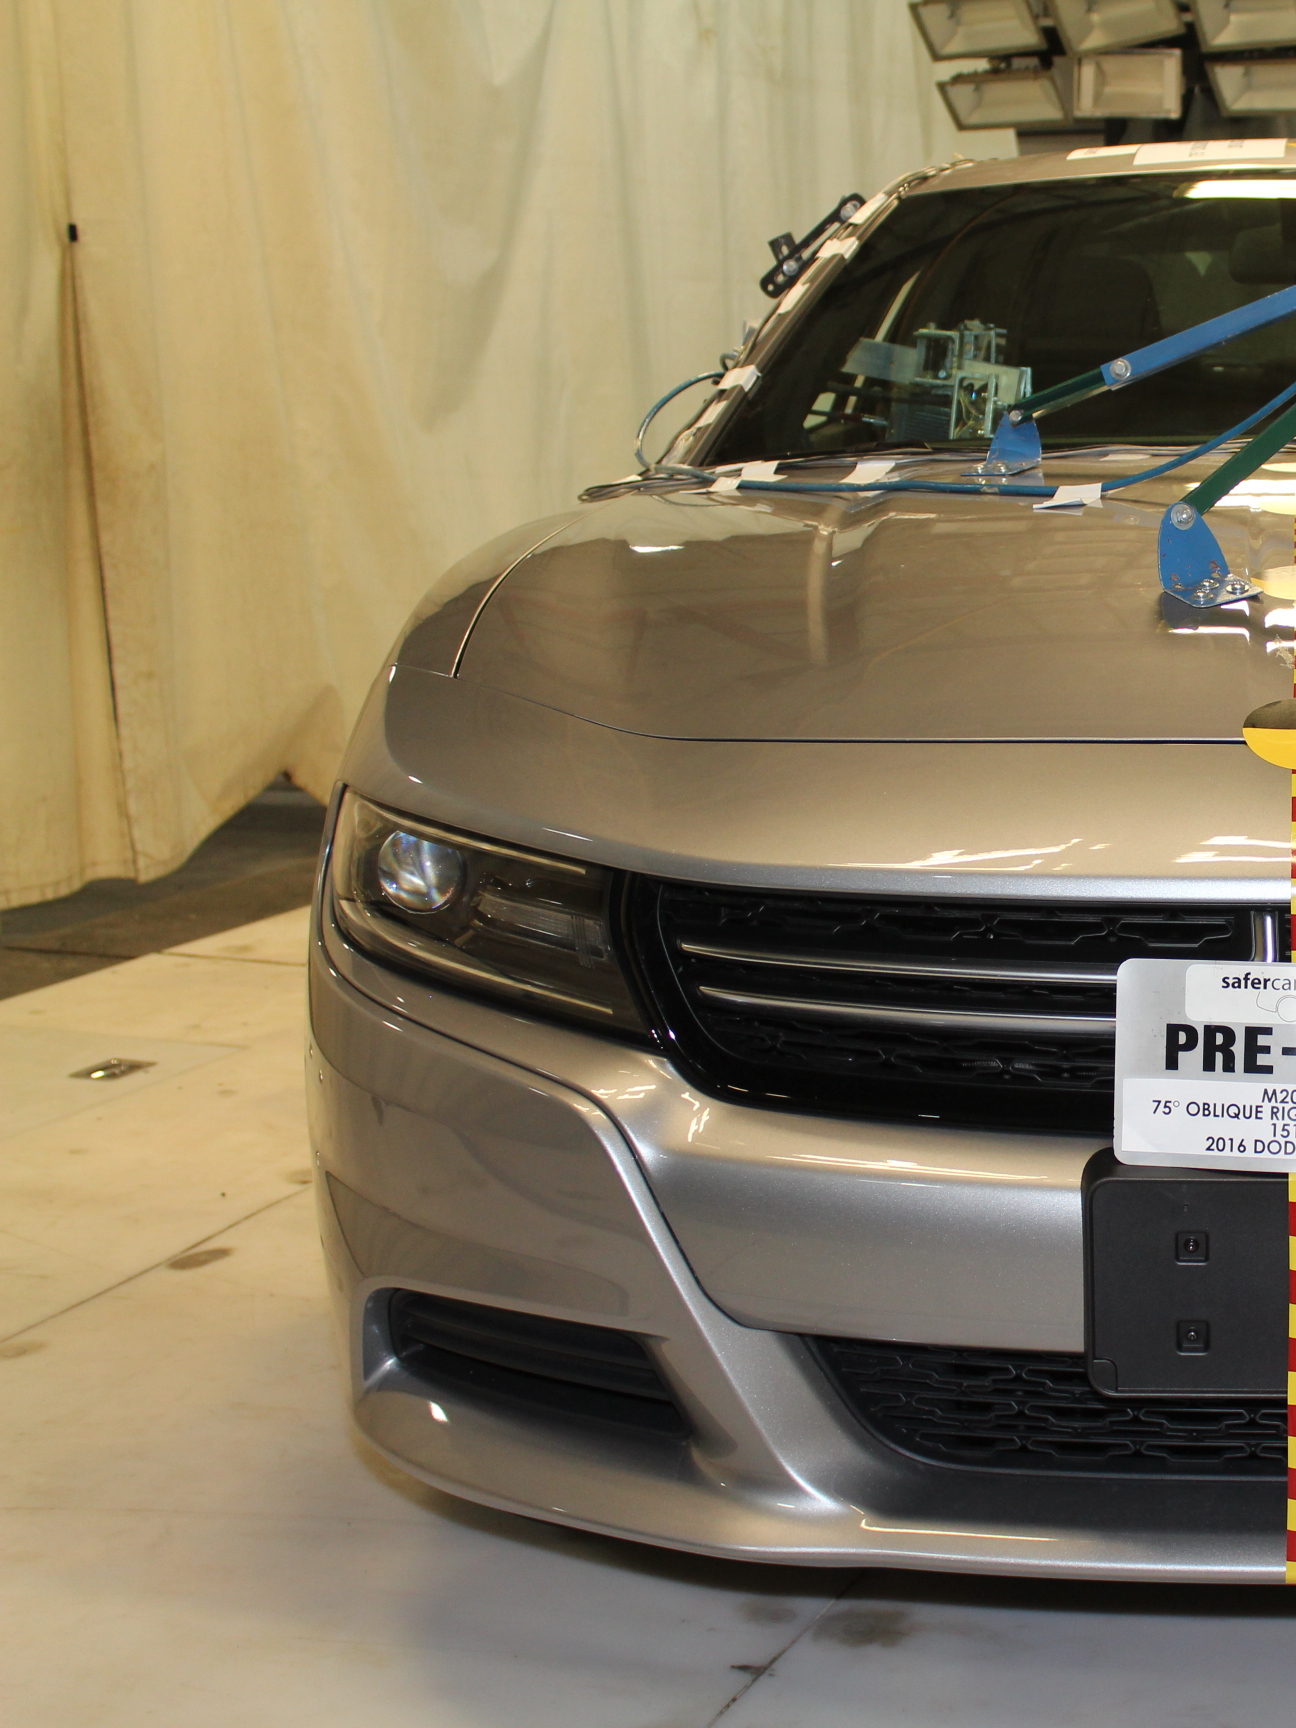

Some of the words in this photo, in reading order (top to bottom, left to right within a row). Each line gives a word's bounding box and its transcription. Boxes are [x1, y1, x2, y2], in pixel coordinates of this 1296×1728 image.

[1151, 1099, 1181, 1116] 75°
[1185, 1101, 1264, 1120] OBLIQUE
[1204, 1136, 1247, 1154] 2016
